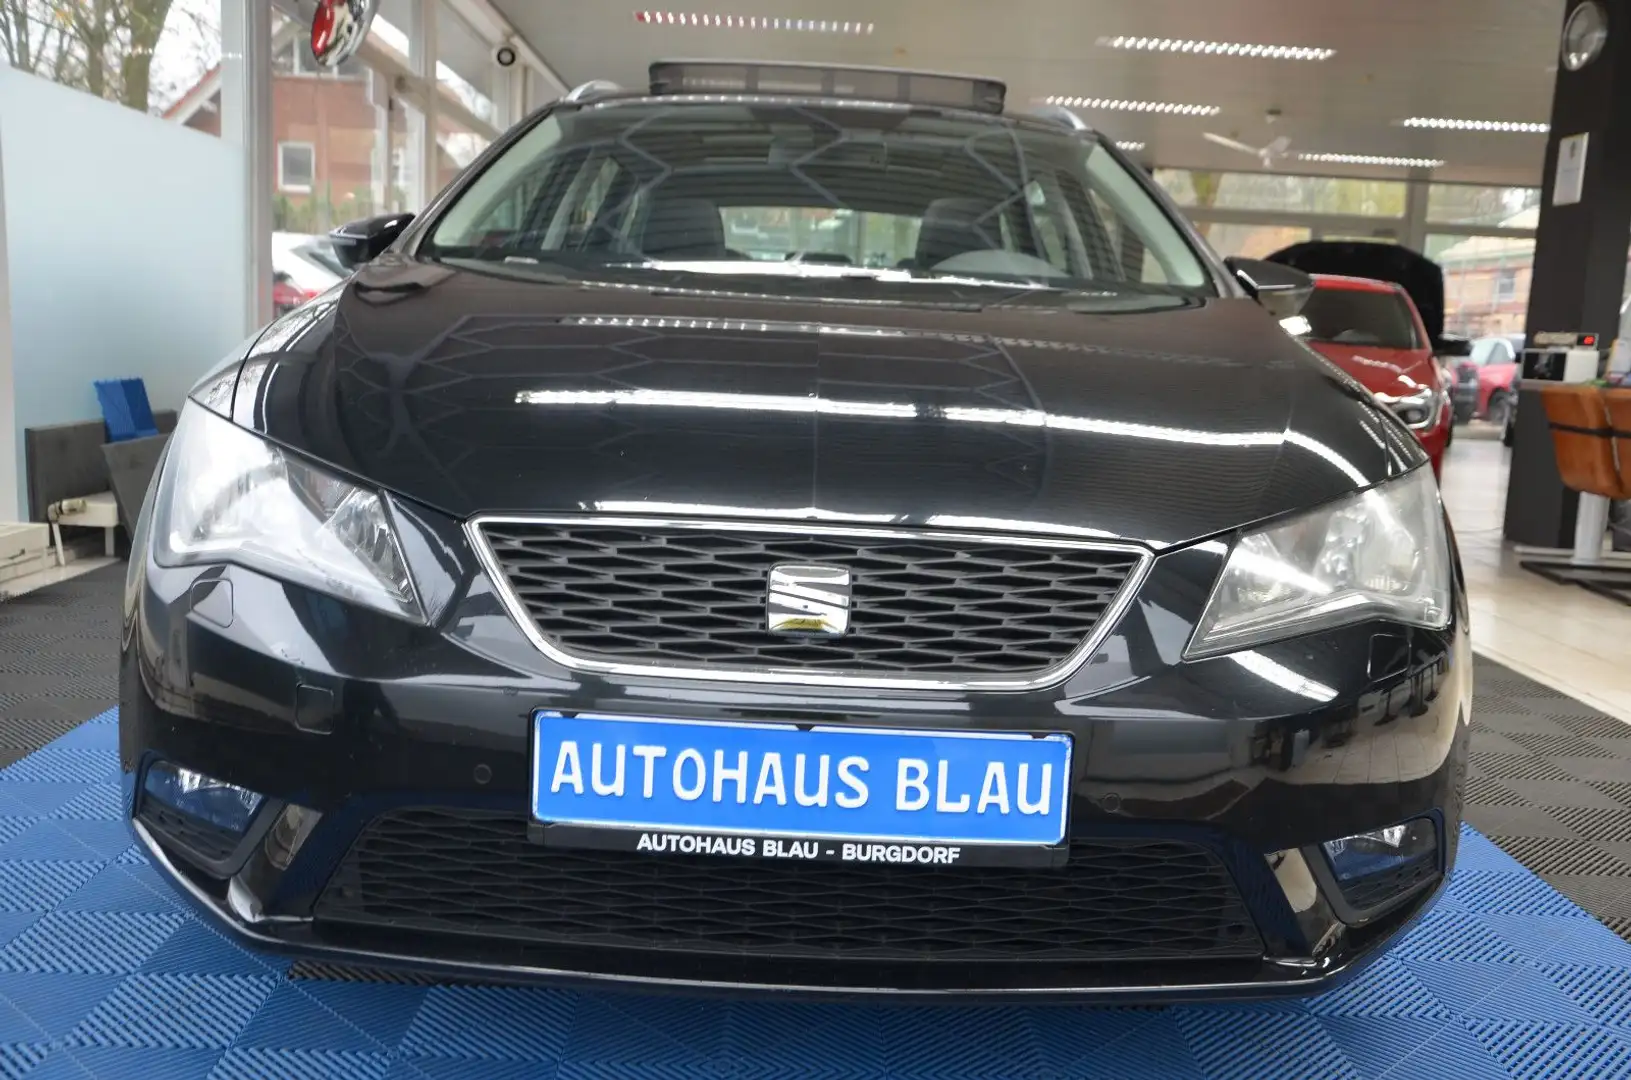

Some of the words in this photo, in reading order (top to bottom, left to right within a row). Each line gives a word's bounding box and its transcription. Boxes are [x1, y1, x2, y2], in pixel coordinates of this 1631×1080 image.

[550, 740, 870, 809] AUTOHAUS
[896, 758, 1053, 815] BLAU
[636, 833, 756, 856] AUTOHAUS
[762, 839, 819, 859] BLAU
[841, 843, 961, 864] BURGDORF
